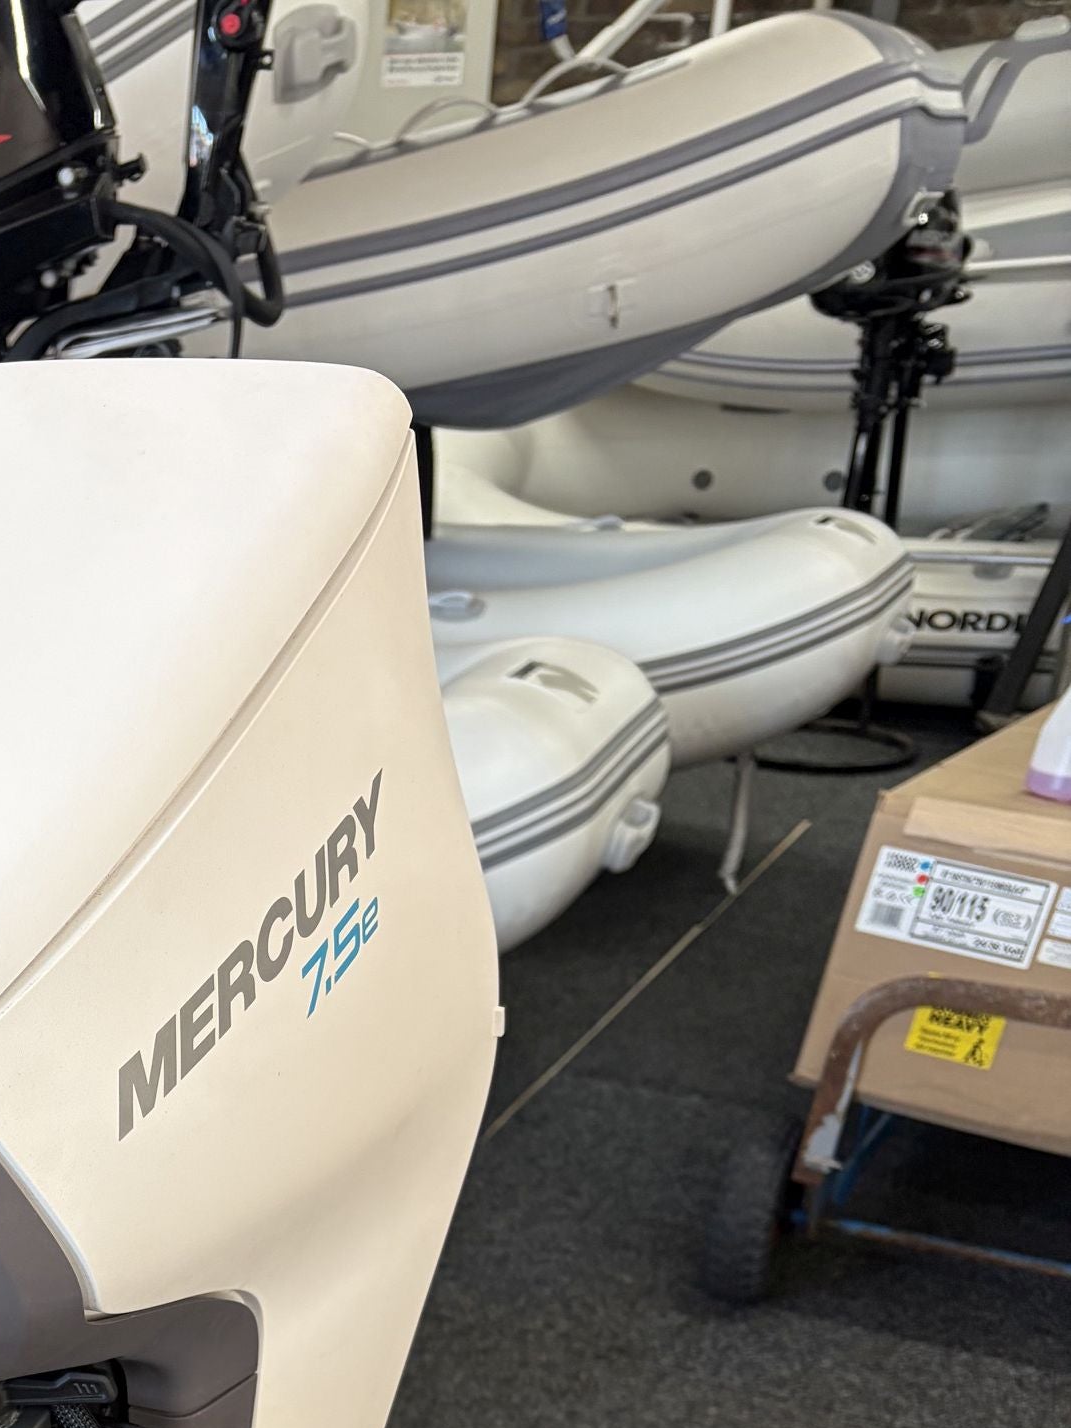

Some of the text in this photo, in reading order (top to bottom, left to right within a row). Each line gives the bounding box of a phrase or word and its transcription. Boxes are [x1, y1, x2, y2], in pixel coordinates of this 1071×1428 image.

[906, 609, 1028, 633] NORDI
[118, 767, 383, 1142] MERCURY
[301, 896, 379, 1020] 7.5e
